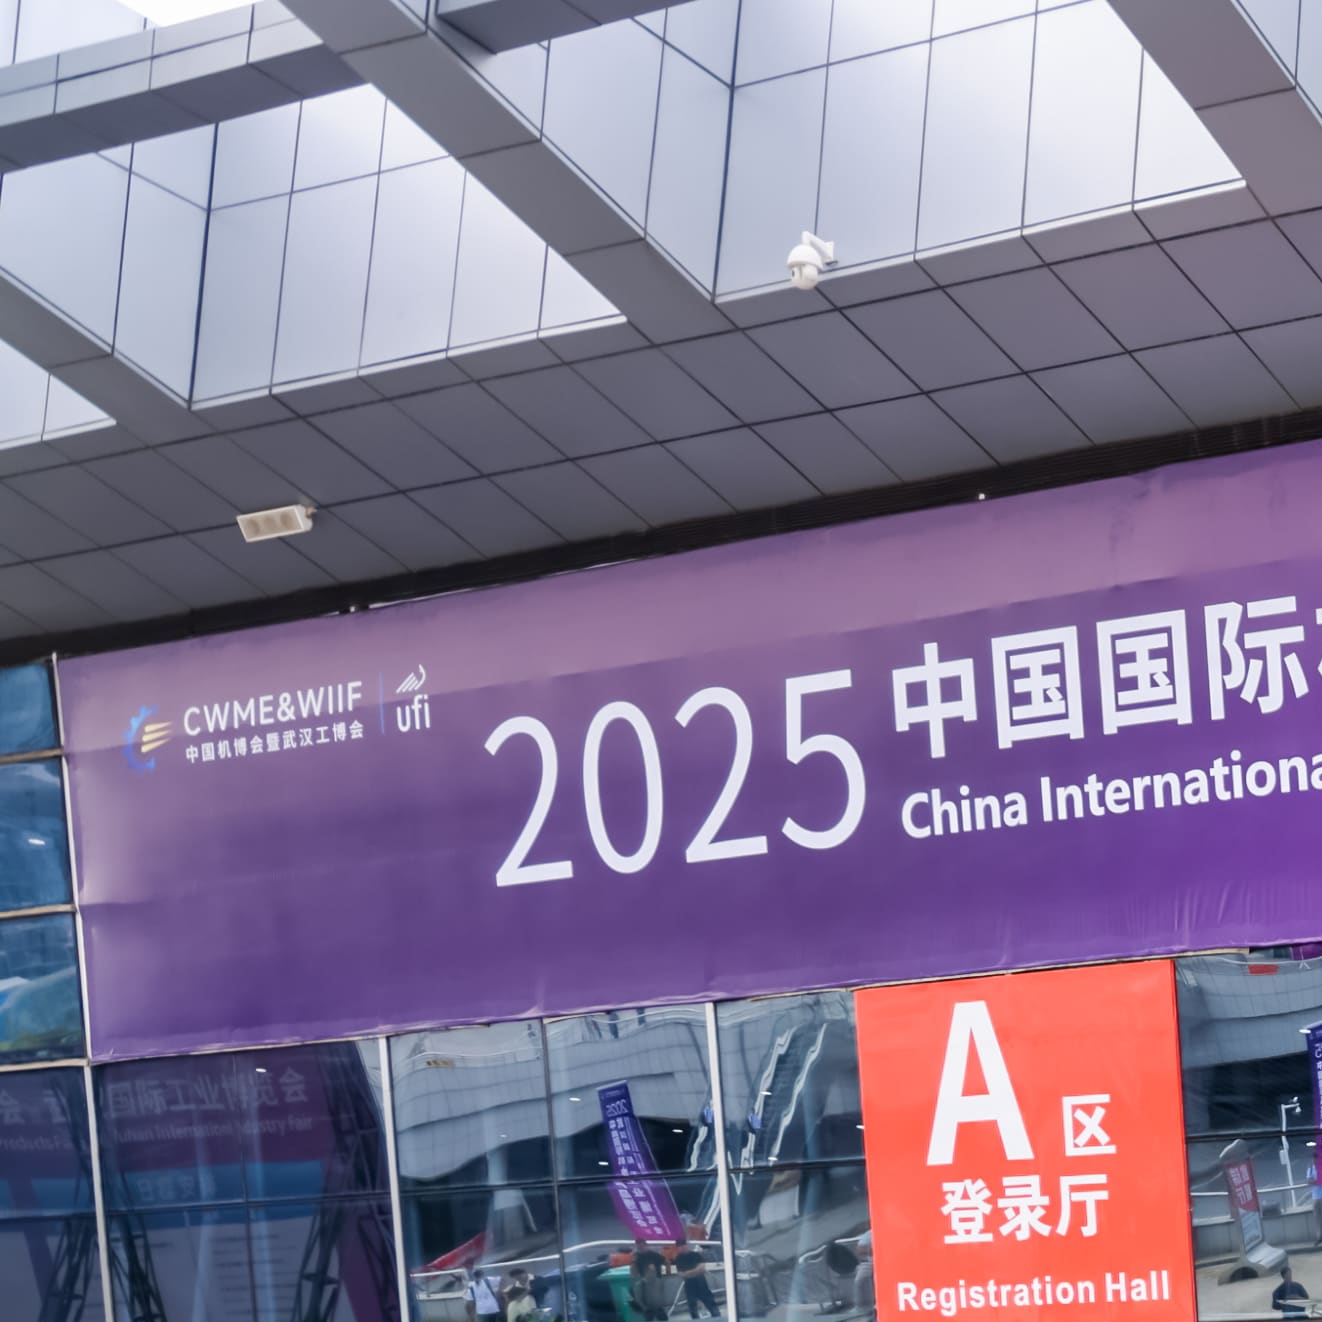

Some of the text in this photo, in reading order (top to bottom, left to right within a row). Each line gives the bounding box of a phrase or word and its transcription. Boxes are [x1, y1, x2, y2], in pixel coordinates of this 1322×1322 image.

[183, 680, 363, 737] CWME&WIIF
[396, 694, 431, 733] ufi
[185, 719, 364, 764] 中国机博会暨武汉工博会
[484, 669, 866, 888] 2025
[900, 784, 1028, 838] China
[940, 1172, 1110, 1245] 登录厅
[898, 1270, 1170, 1318] Registration Hall
